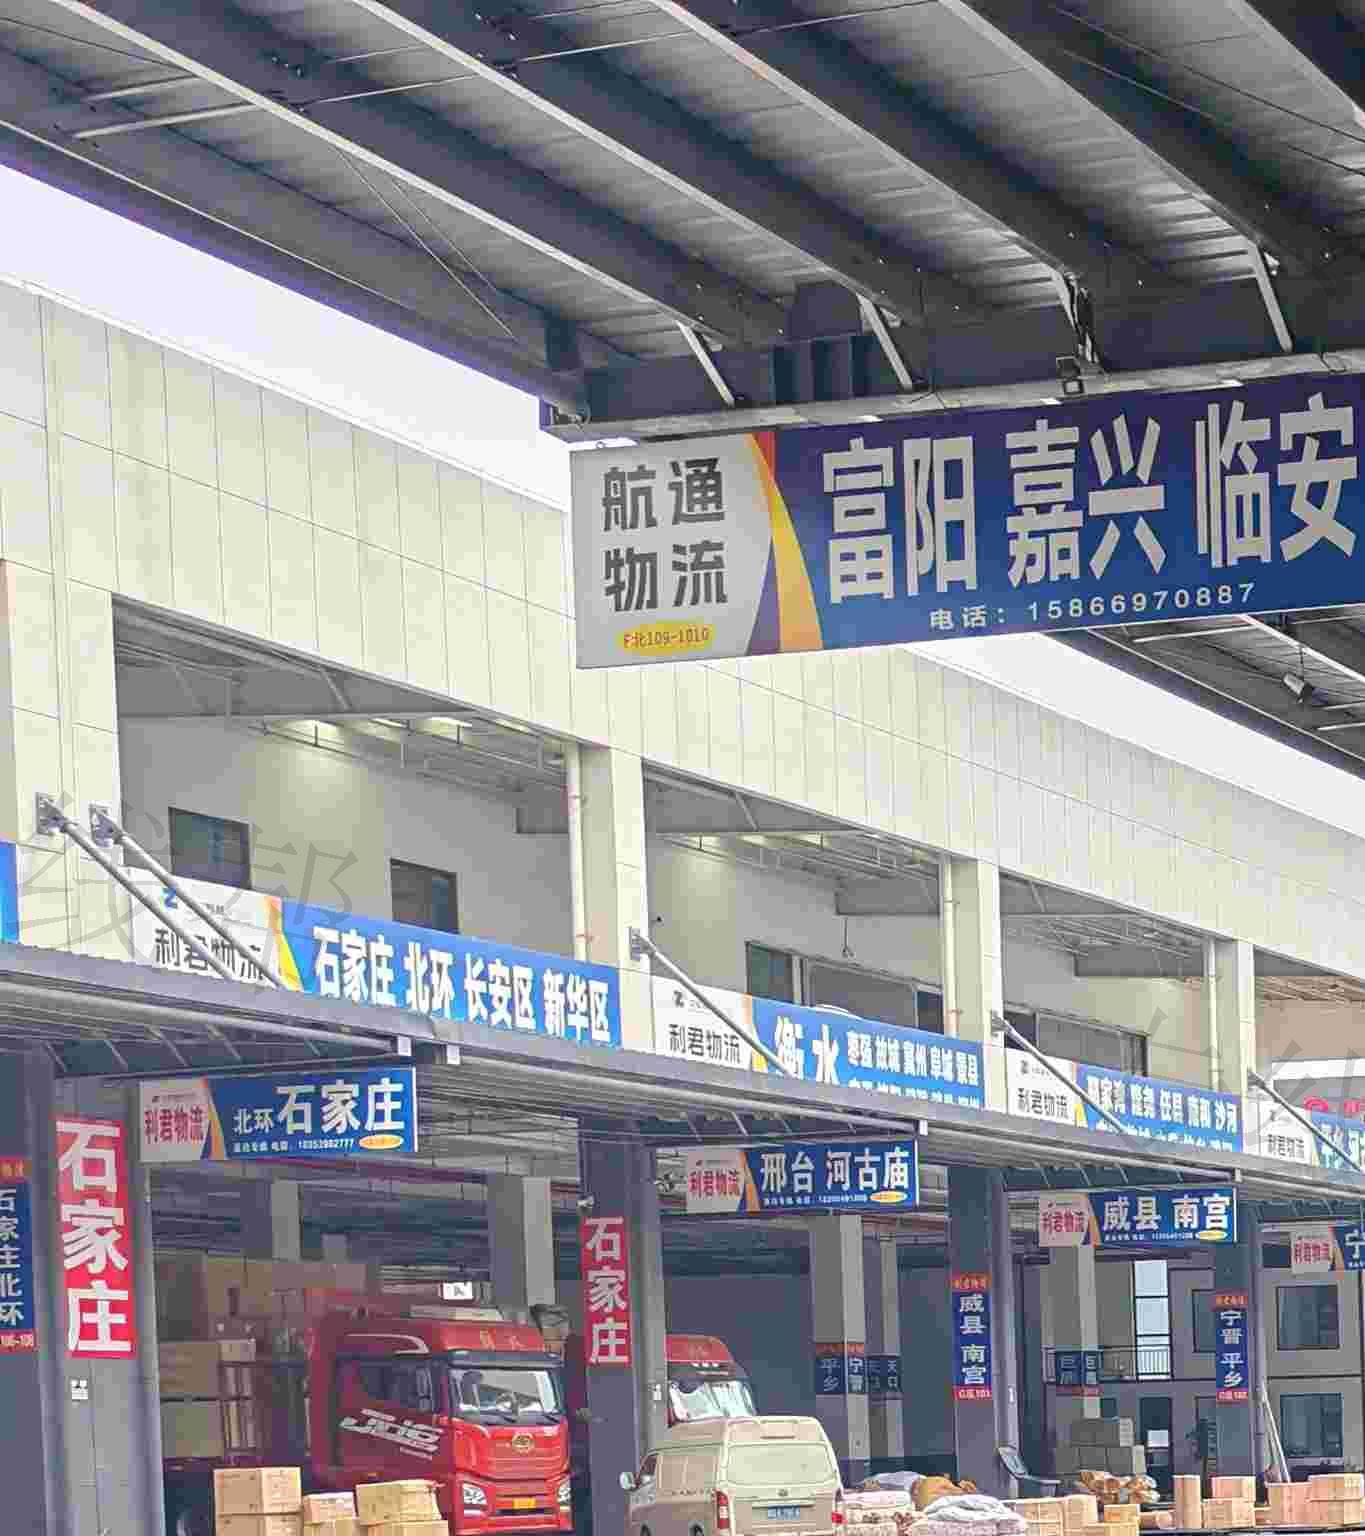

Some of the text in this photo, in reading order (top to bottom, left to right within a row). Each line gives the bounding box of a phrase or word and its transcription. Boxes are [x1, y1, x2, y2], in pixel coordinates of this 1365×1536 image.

[603, 455, 726, 534] 航通
[822, 391, 1359, 605] 富阳 嘉兴 临安
[603, 538, 729, 614] 物流
[312, 925, 611, 1043] 石家庄 北环 长安区 新华区
[668, 1023, 741, 1064] 利君物流
[774, 1017, 839, 1085] 衡水
[144, 1109, 273, 1145] 利君物流 北环
[276, 1079, 405, 1135] 石家庄
[688, 1167, 741, 1199] 利君物流
[760, 1146, 910, 1193] 邢台 河古庙
[55, 1119, 132, 1353] 石家庄
[1103, 1193, 1231, 1233] 威县 南宫
[584, 1216, 630, 1365] 石家庄
[959, 1294, 987, 1334] 威县
[1220, 1310, 1243, 1345] 宁晋
[960, 1344, 987, 1385] 南宫
[1220, 1352, 1244, 1388] 平乡
